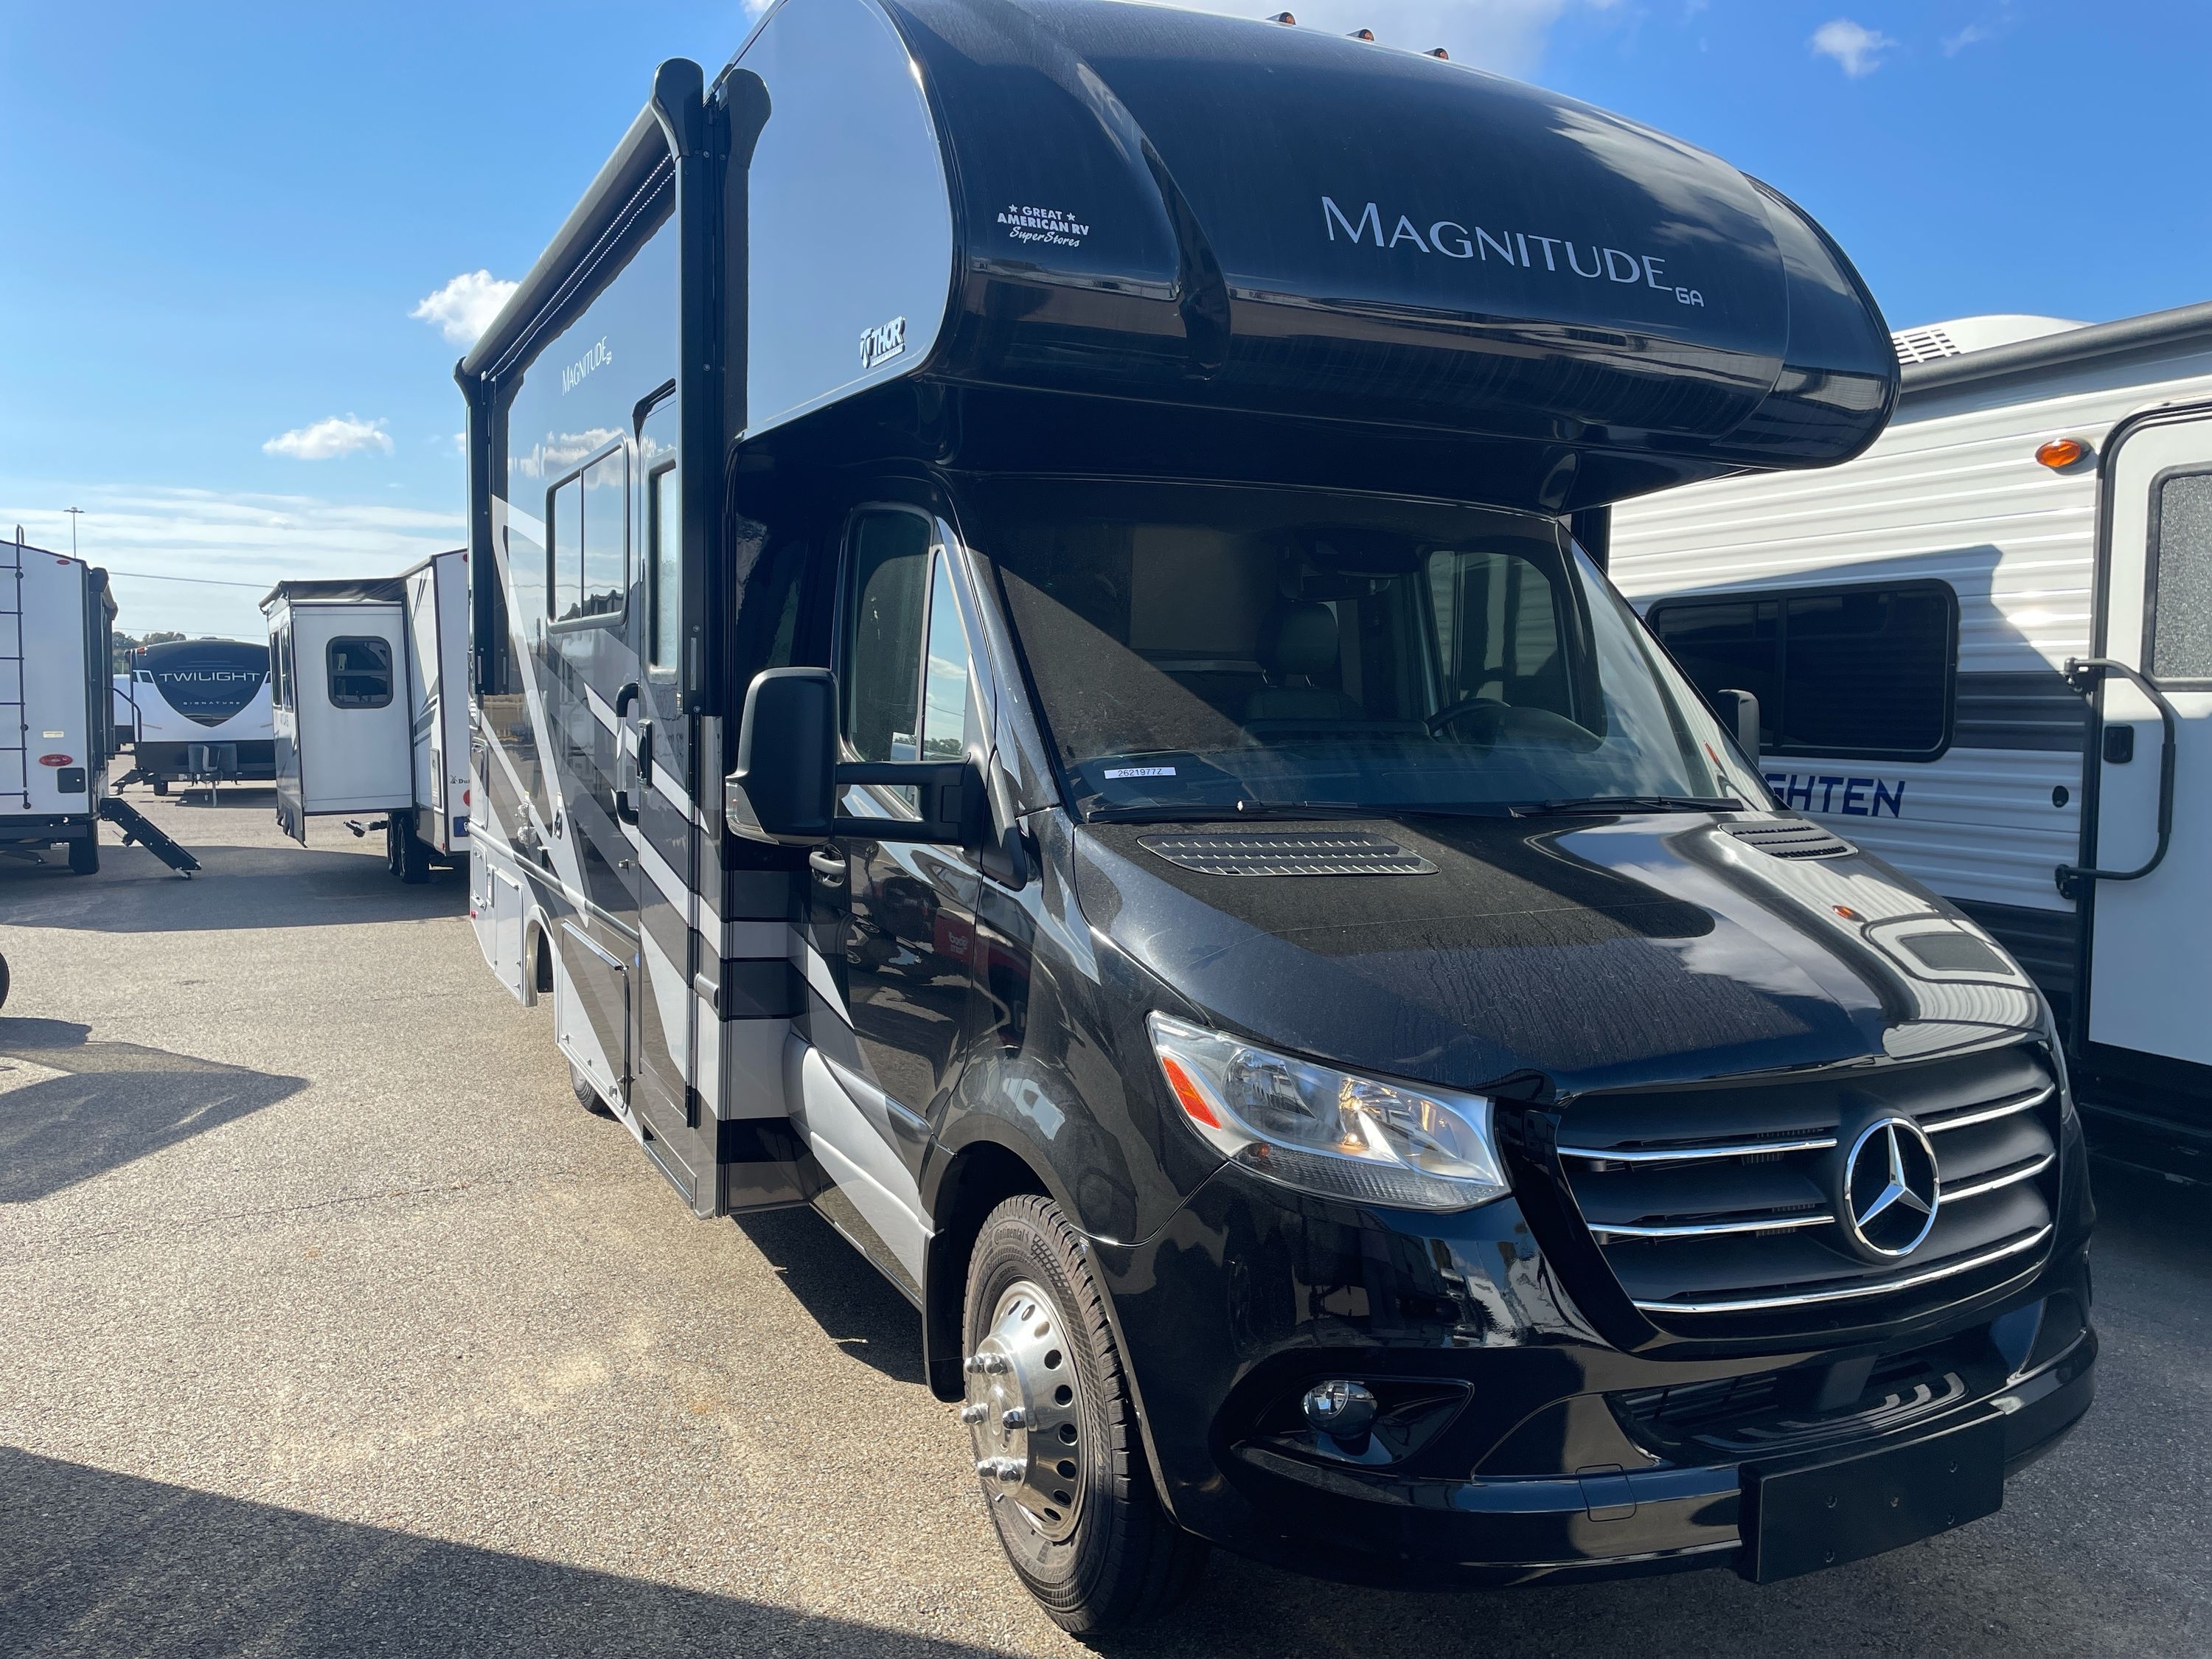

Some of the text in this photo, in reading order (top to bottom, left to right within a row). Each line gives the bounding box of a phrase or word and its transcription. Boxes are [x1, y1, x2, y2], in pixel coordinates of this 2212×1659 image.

[997, 212, 1089, 235] AMERICAN RV
[1022, 206, 1062, 220] GREAT
[1321, 195, 1704, 307] MAGNITUDE GA
[872, 316, 905, 356] THOR
[562, 335, 608, 396] MAGNITUDE
[159, 672, 260, 682] TWILIGHT
[1117, 768, 1163, 777] 2621977Z
[994, 1225, 1026, 1245] Continental
